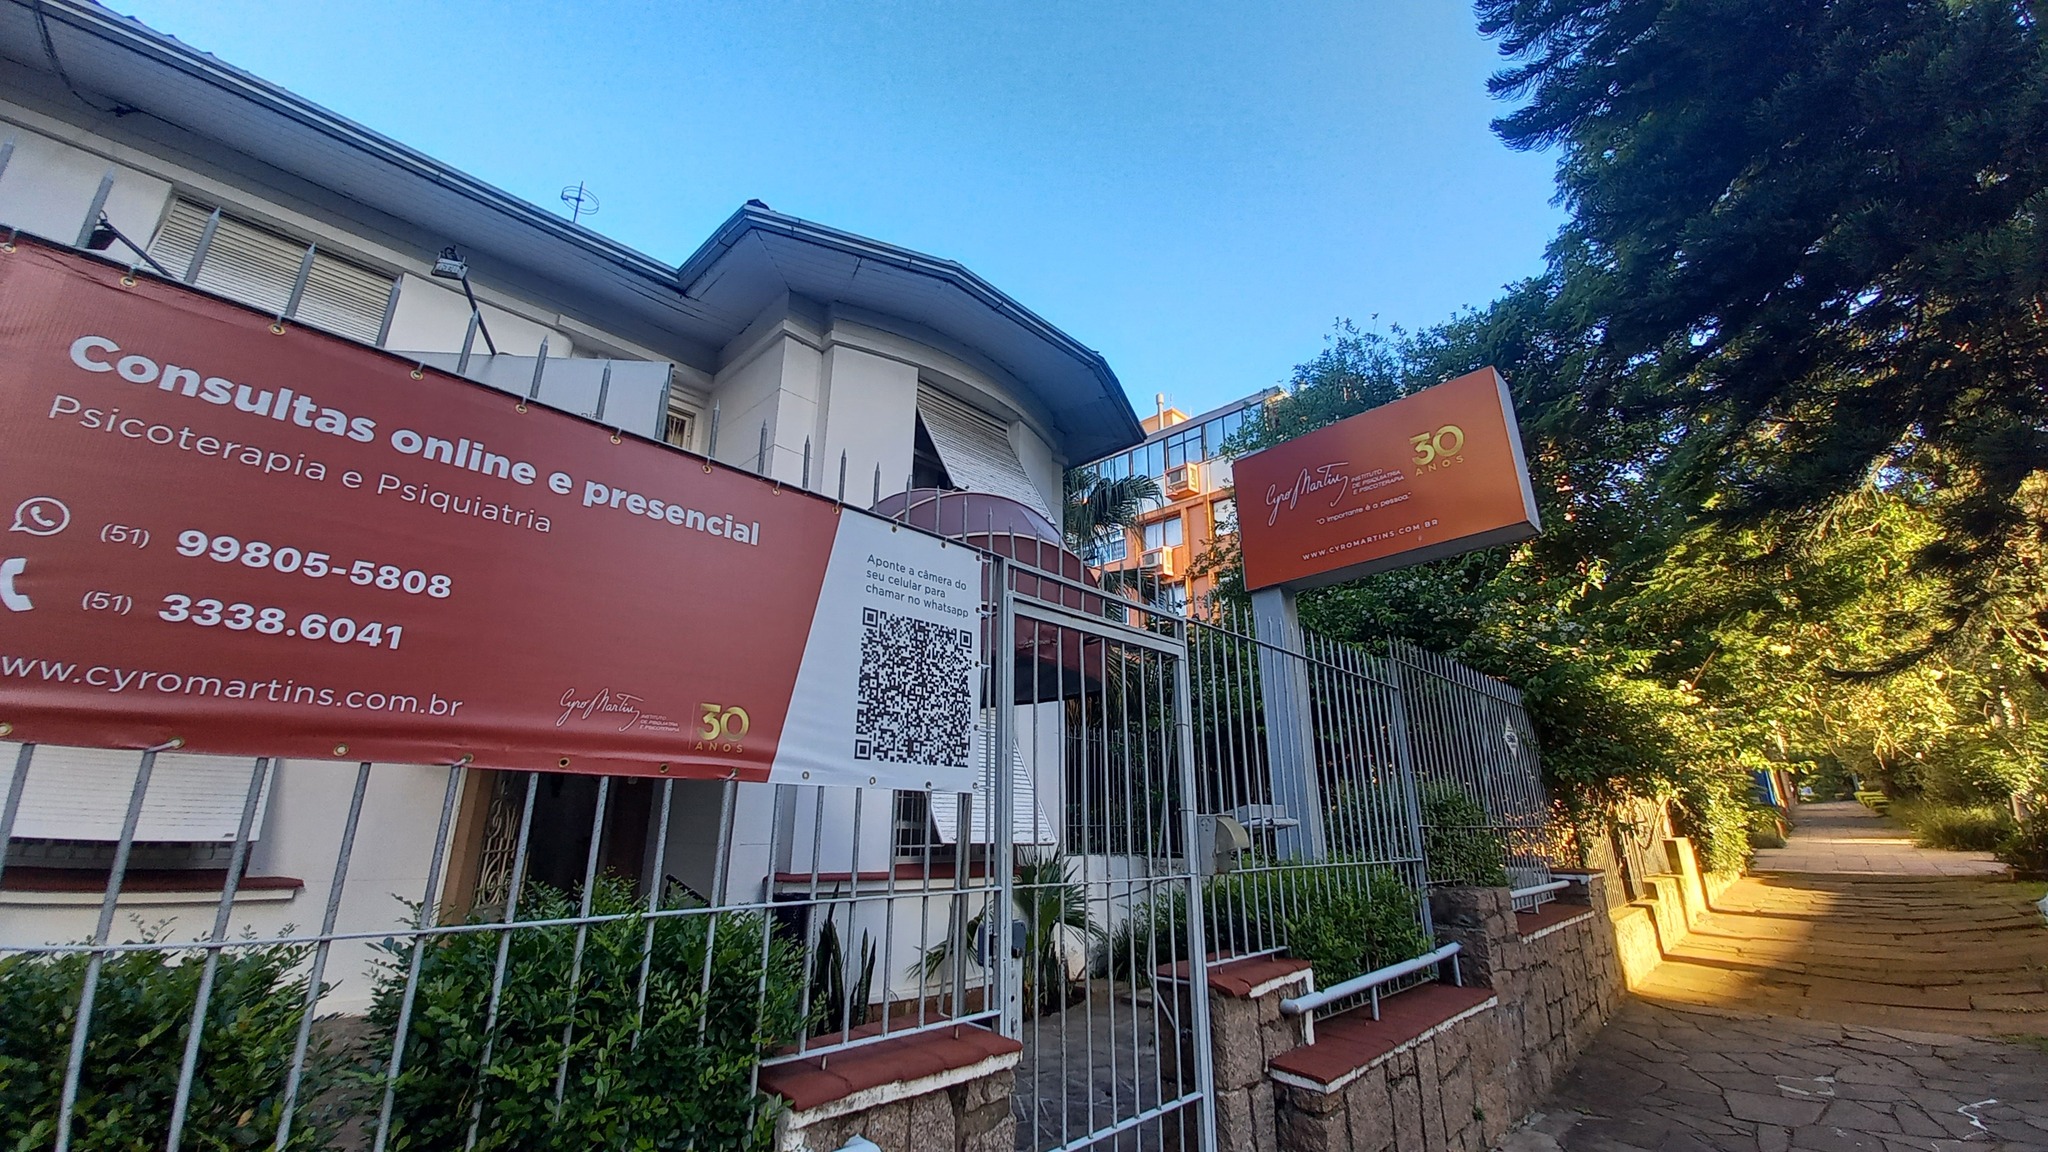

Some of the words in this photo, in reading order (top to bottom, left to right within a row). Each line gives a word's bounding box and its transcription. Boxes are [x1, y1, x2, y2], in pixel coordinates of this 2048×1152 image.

[69, 335, 377, 444] Consultas
[391, 428, 537, 488] online
[548, 471, 572, 495] e
[583, 480, 761, 547] presencial
[1409, 425, 1464, 466] 30
[48, 394, 326, 482] Psicoterapia
[341, 467, 363, 489] e
[377, 473, 552, 534] Psiquiatria
[1351, 468, 1383, 482] INSTITUTO
[1352, 481, 1361, 489] DE
[1362, 470, 1401, 486] PSIQUIATRIA
[1415, 455, 1464, 477] ANOS
[1266, 484, 1293, 527] Cyro
[1290, 462, 1349, 510] Martins
[1359, 474, 1405, 493] PSICOTERAPIA
[1327, 507, 1363, 522] importante
[100, 523, 150, 550] (51)
[176, 530, 452, 600] 99805-5808
[867, 554, 906, 573] Aponte
[908, 567, 915, 576] a
[917, 570, 952, 586] câmera
[955, 579, 967, 591] do
[865, 583, 905, 601] chamar
[907, 595, 921, 605] no
[923, 599, 969, 618] whatsapp
[866, 570, 885, 582] seu
[888, 577, 922, 592] celular
[924, 586, 946, 598] para
[81, 591, 133, 616] (51)
[158, 594, 403, 650] 3338.6041
[556, 688, 593, 727] Cyro
[581, 687, 644, 732] Martins
[698, 702, 750, 742] 30
[695, 741, 744, 753] ANOS
